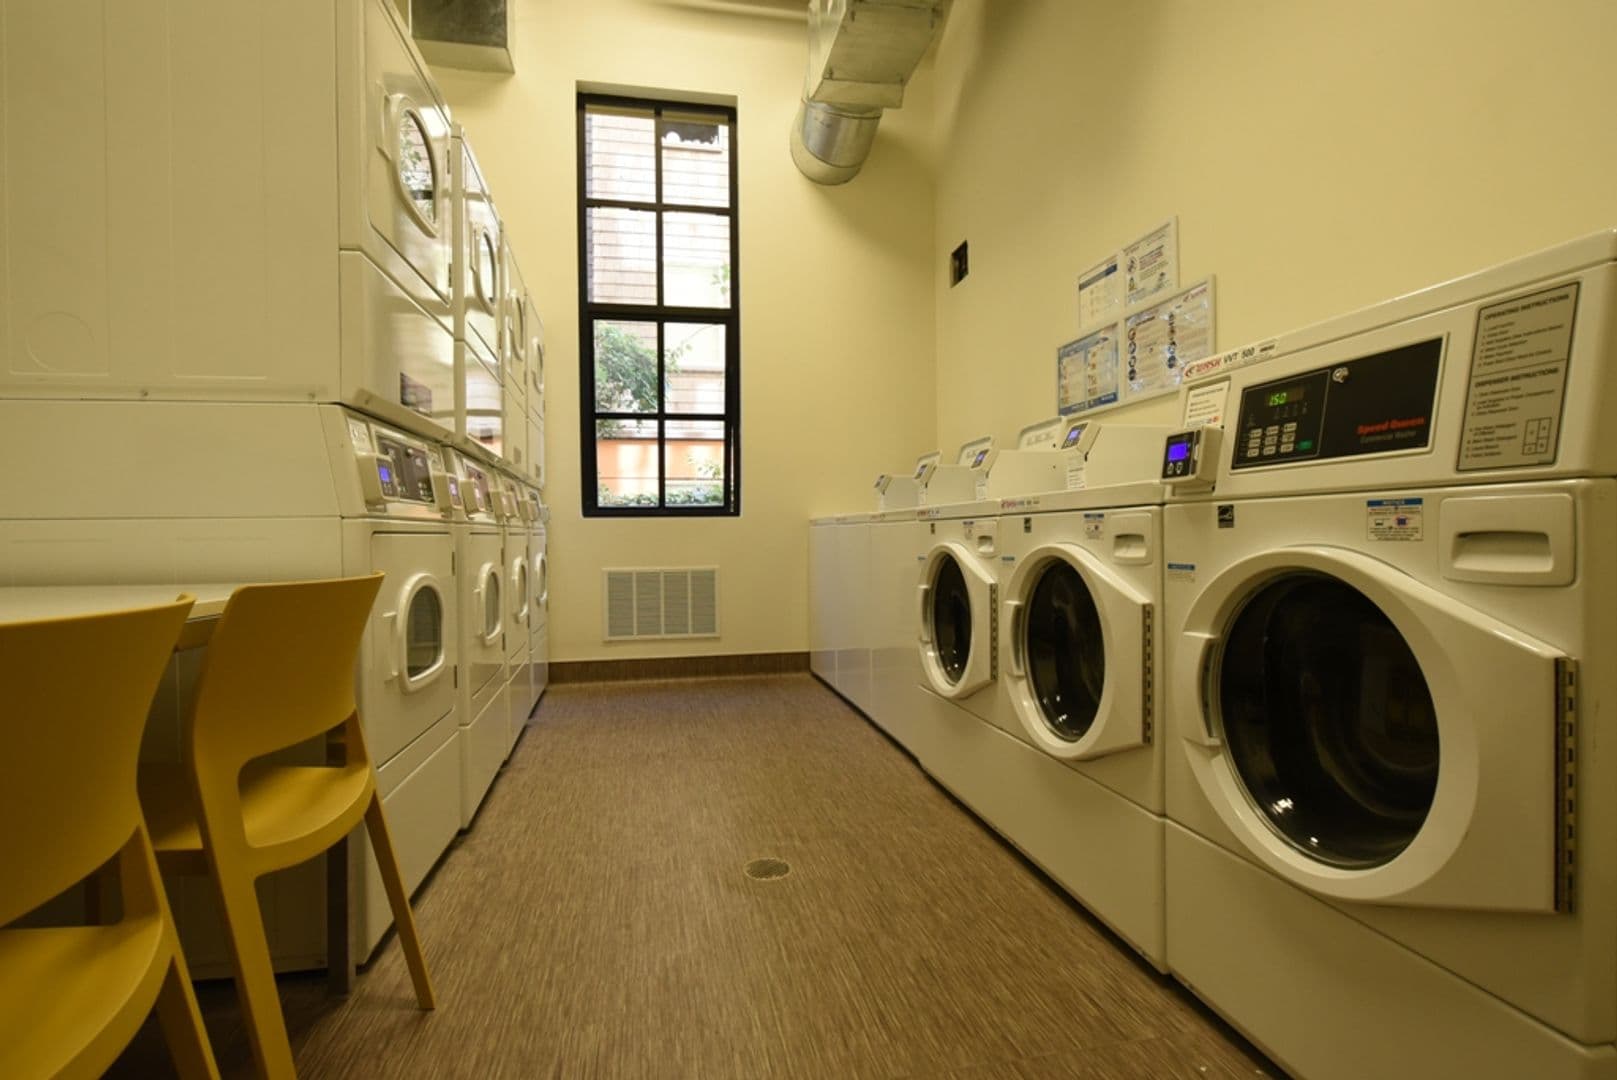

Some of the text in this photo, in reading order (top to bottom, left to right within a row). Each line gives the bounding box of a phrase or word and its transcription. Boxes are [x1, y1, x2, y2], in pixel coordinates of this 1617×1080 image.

[1520, 294, 1570, 310] INSTRUCTIONS
[1511, 368, 1559, 381] INSTRUCTIONS
[1357, 418, 1425, 436] Speed Queen
